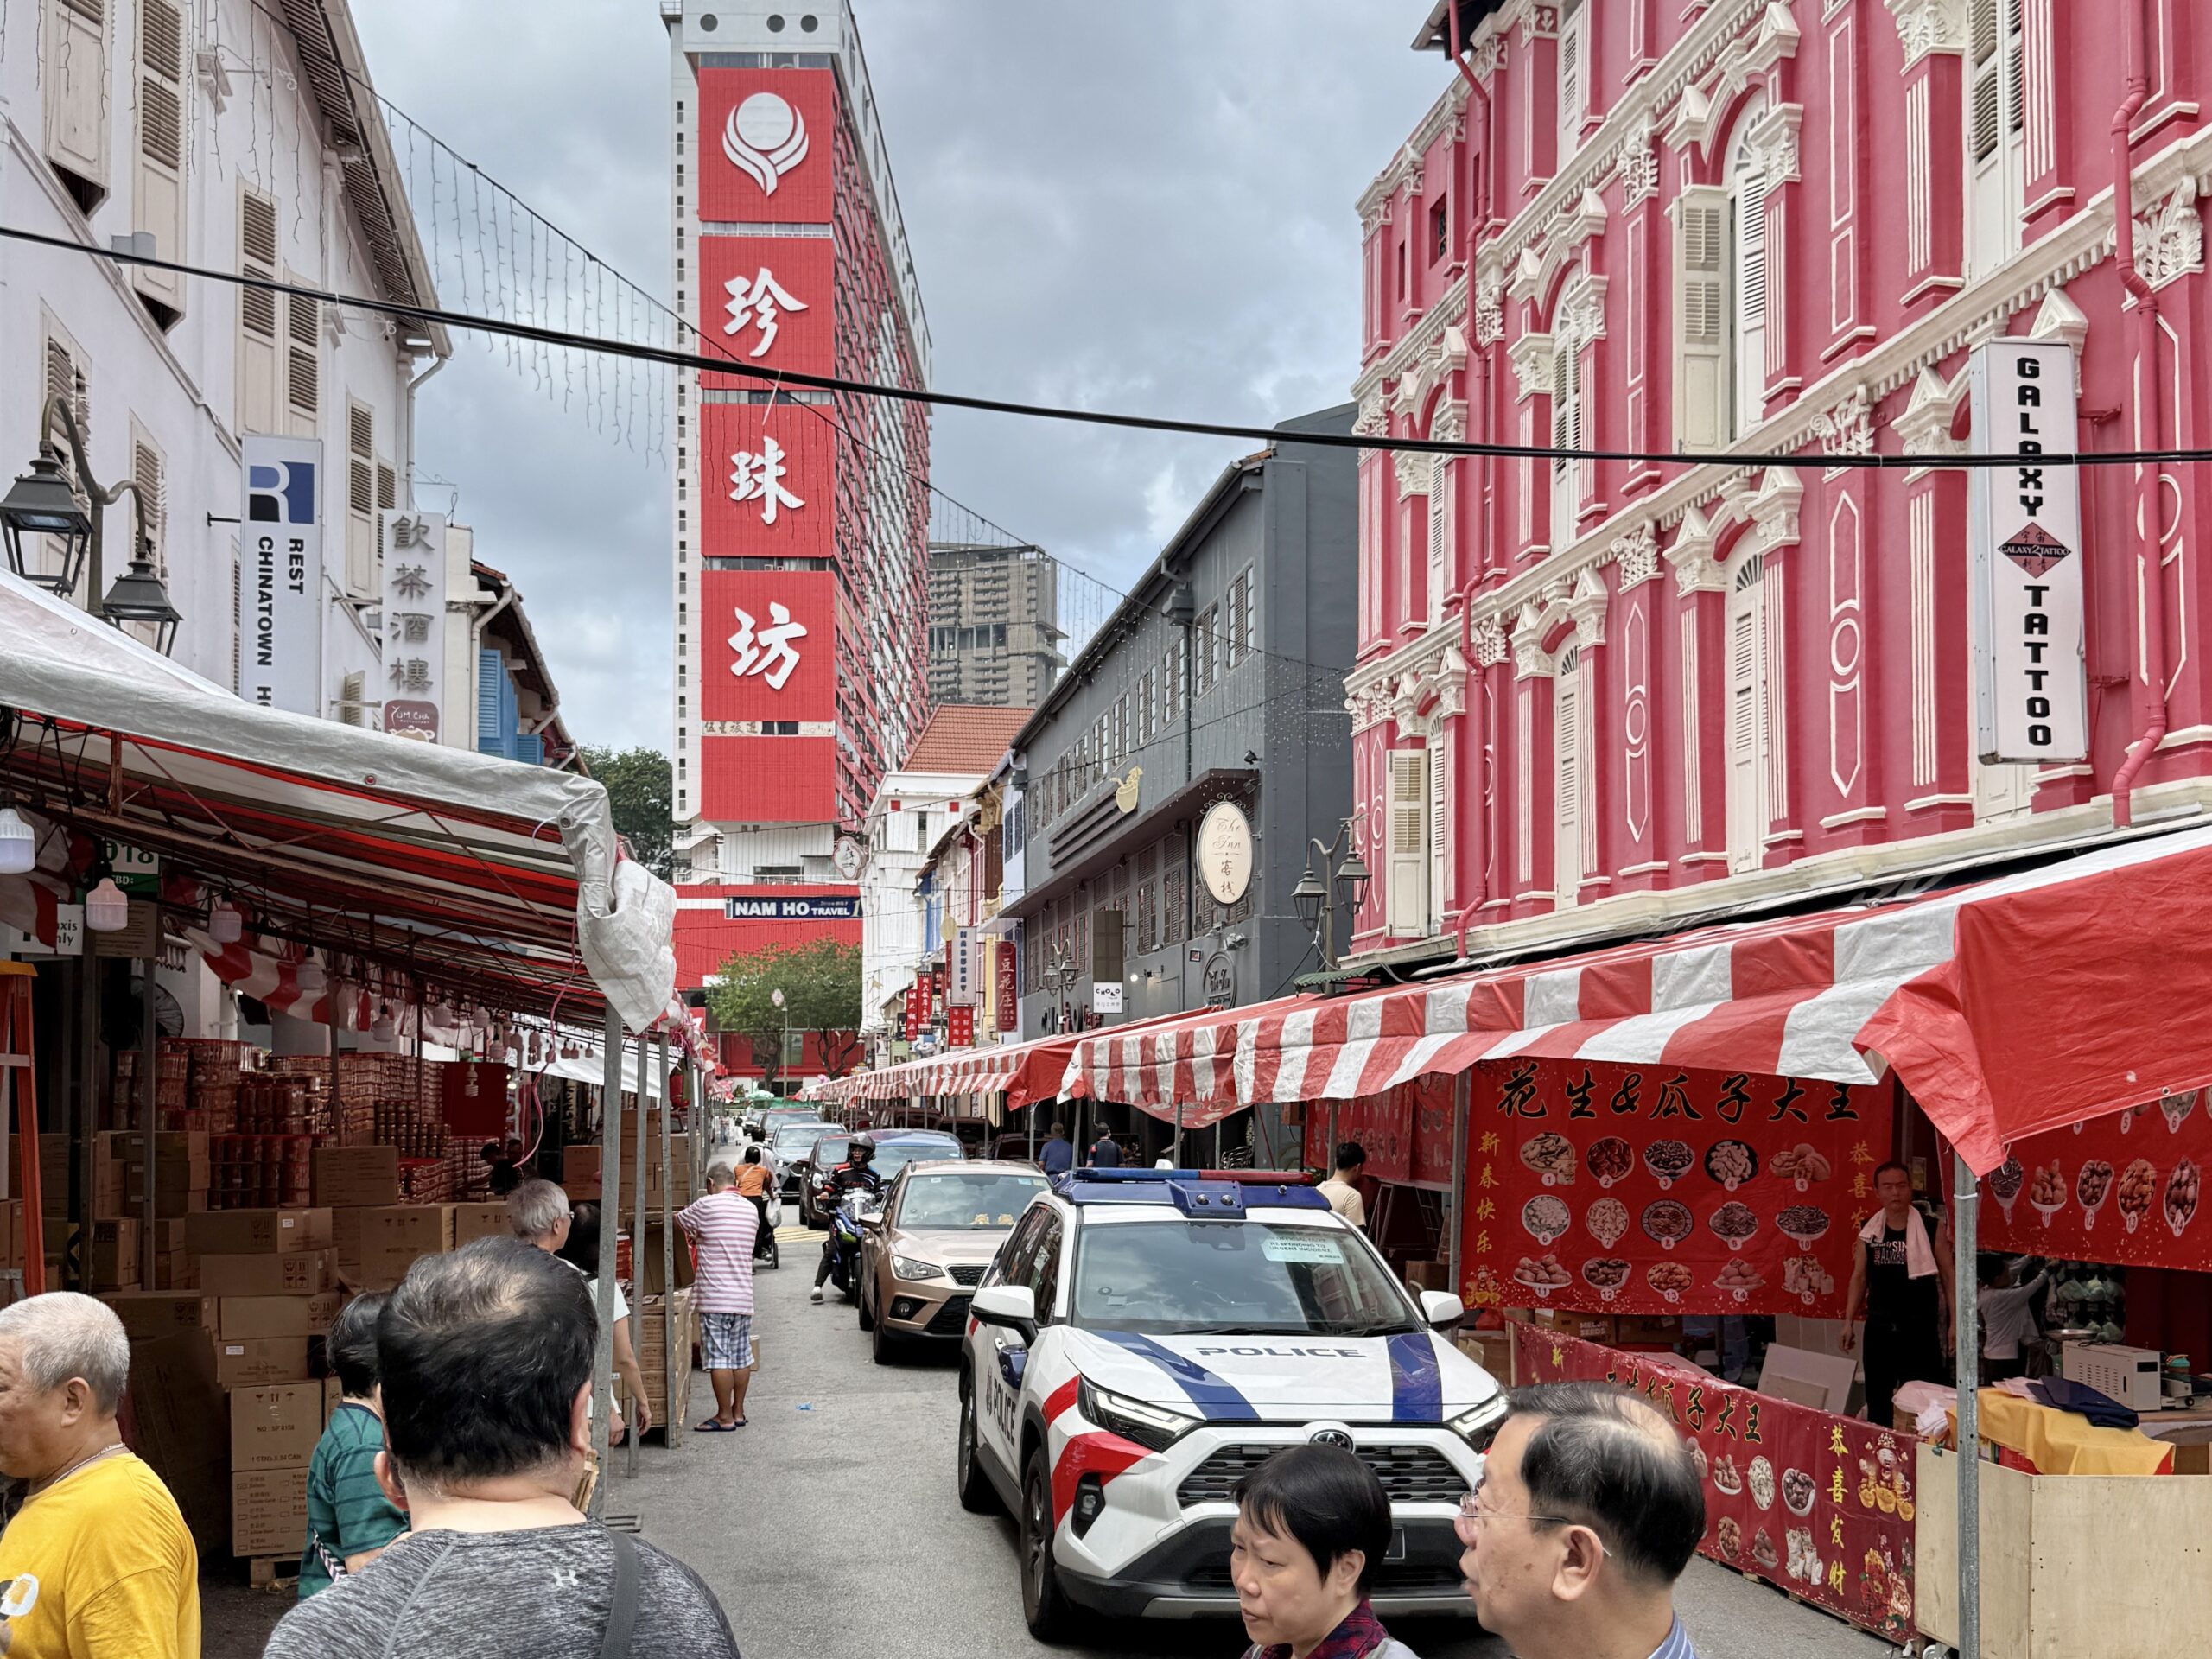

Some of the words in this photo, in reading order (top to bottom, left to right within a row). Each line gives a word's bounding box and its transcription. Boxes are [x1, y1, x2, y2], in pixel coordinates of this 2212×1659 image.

[2016, 357, 2044, 517] GALAXY
[722, 267, 809, 690] 珍珠坊
[289, 538, 304, 595] REST
[257, 536, 275, 666] CHINATOWN
[390, 515, 435, 693] 飲茶酒樓
[2024, 584, 2052, 747] TATTOO
[1212, 835, 1241, 849] Inn
[1217, 817, 1242, 832] The
[735, 901, 777, 916] NAM
[782, 901, 810, 916] HO
[811, 907, 850, 916] TRAVEL
[998, 957, 1014, 1007] 豆花庄
[1497, 1062, 1859, 1124] 花生&瓜子大王
[1476, 1131, 1501, 1254] 新春快乐
[1196, 1347, 1368, 1357] POLICE
[994, 1376, 1016, 1448] POLICE
[1826, 1422, 1849, 1596] 恭喜发财
